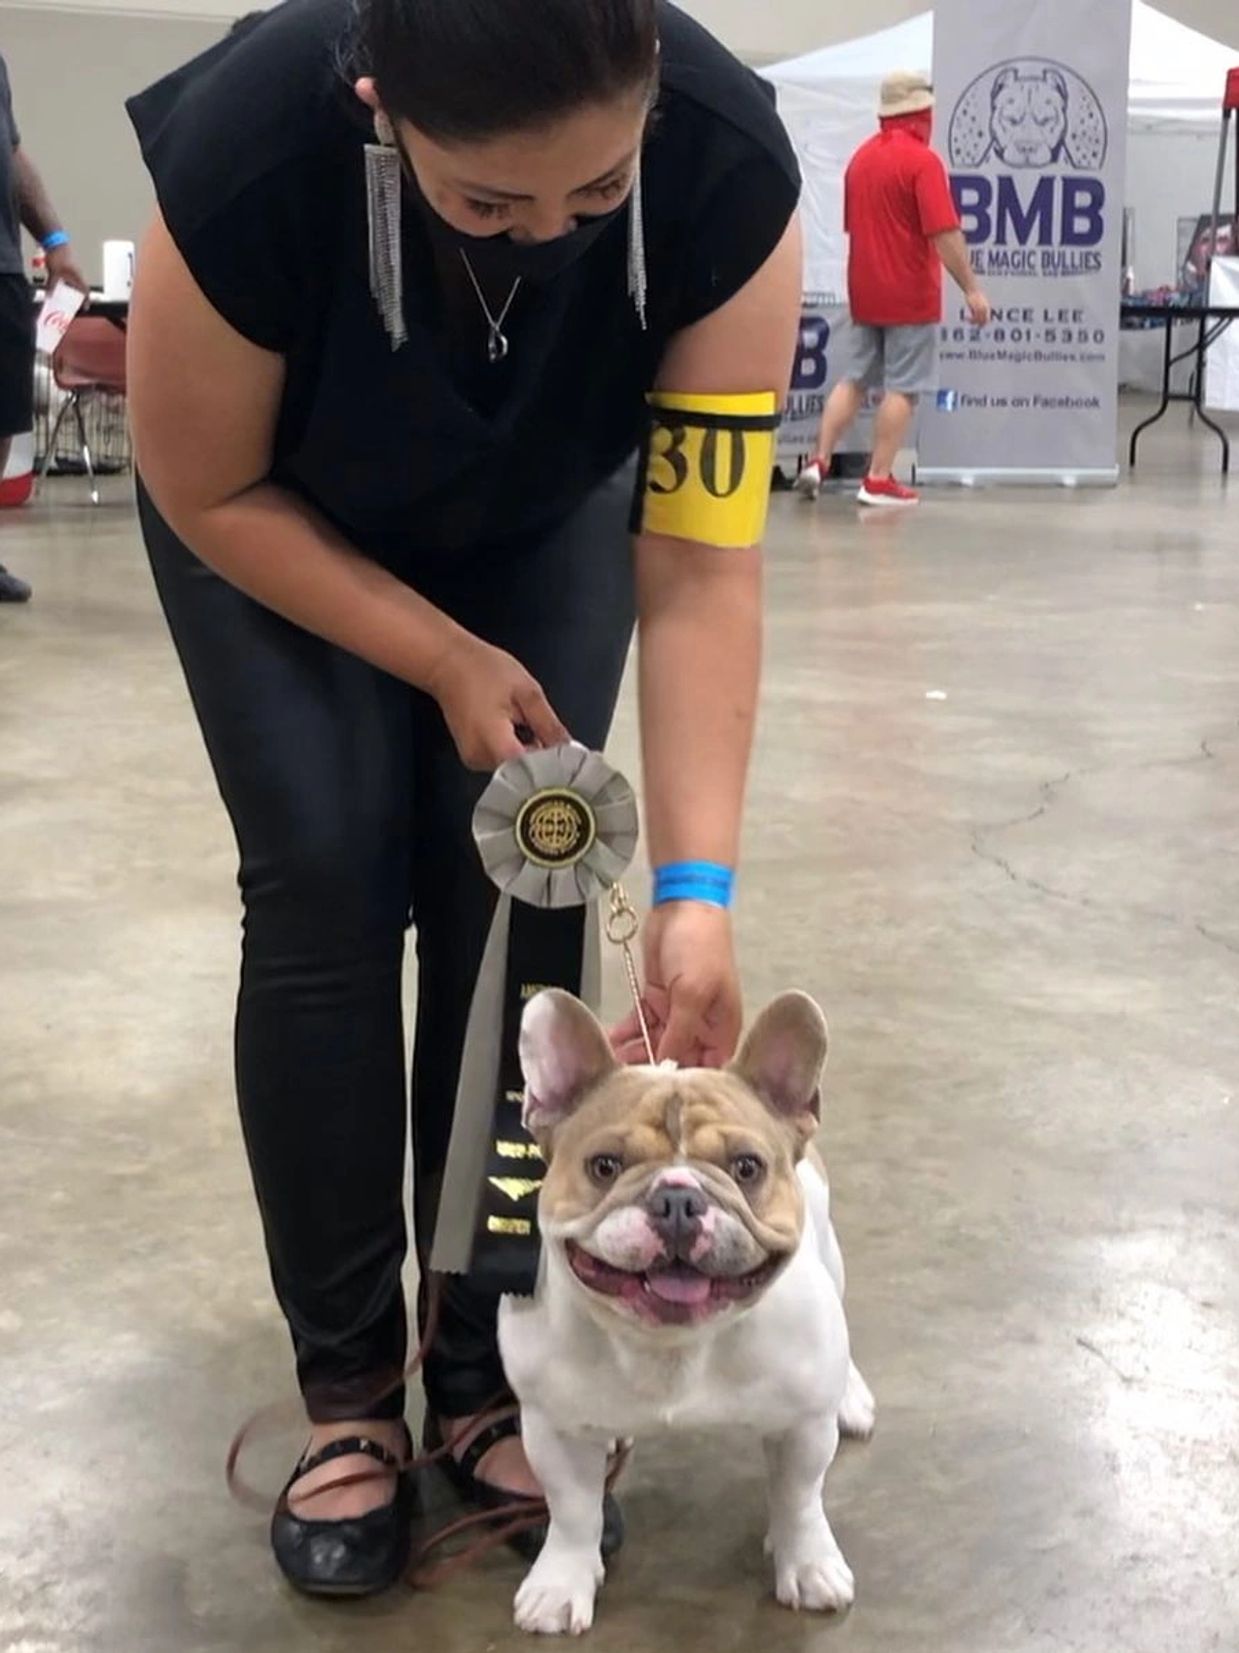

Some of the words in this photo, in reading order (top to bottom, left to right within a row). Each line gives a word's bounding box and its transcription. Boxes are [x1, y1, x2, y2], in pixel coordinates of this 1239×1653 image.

[949, 175, 1105, 246] BMB
[987, 250, 1037, 270] MAGIC
[1041, 250, 1102, 272] BULLIES
[959, 308, 1034, 323] LNCE
[1043, 308, 1084, 323] LEE
[960, 394, 987, 407] find
[991, 396, 1007, 407] us
[1011, 396, 1029, 408] on
[1032, 395, 1100, 409] Facebook
